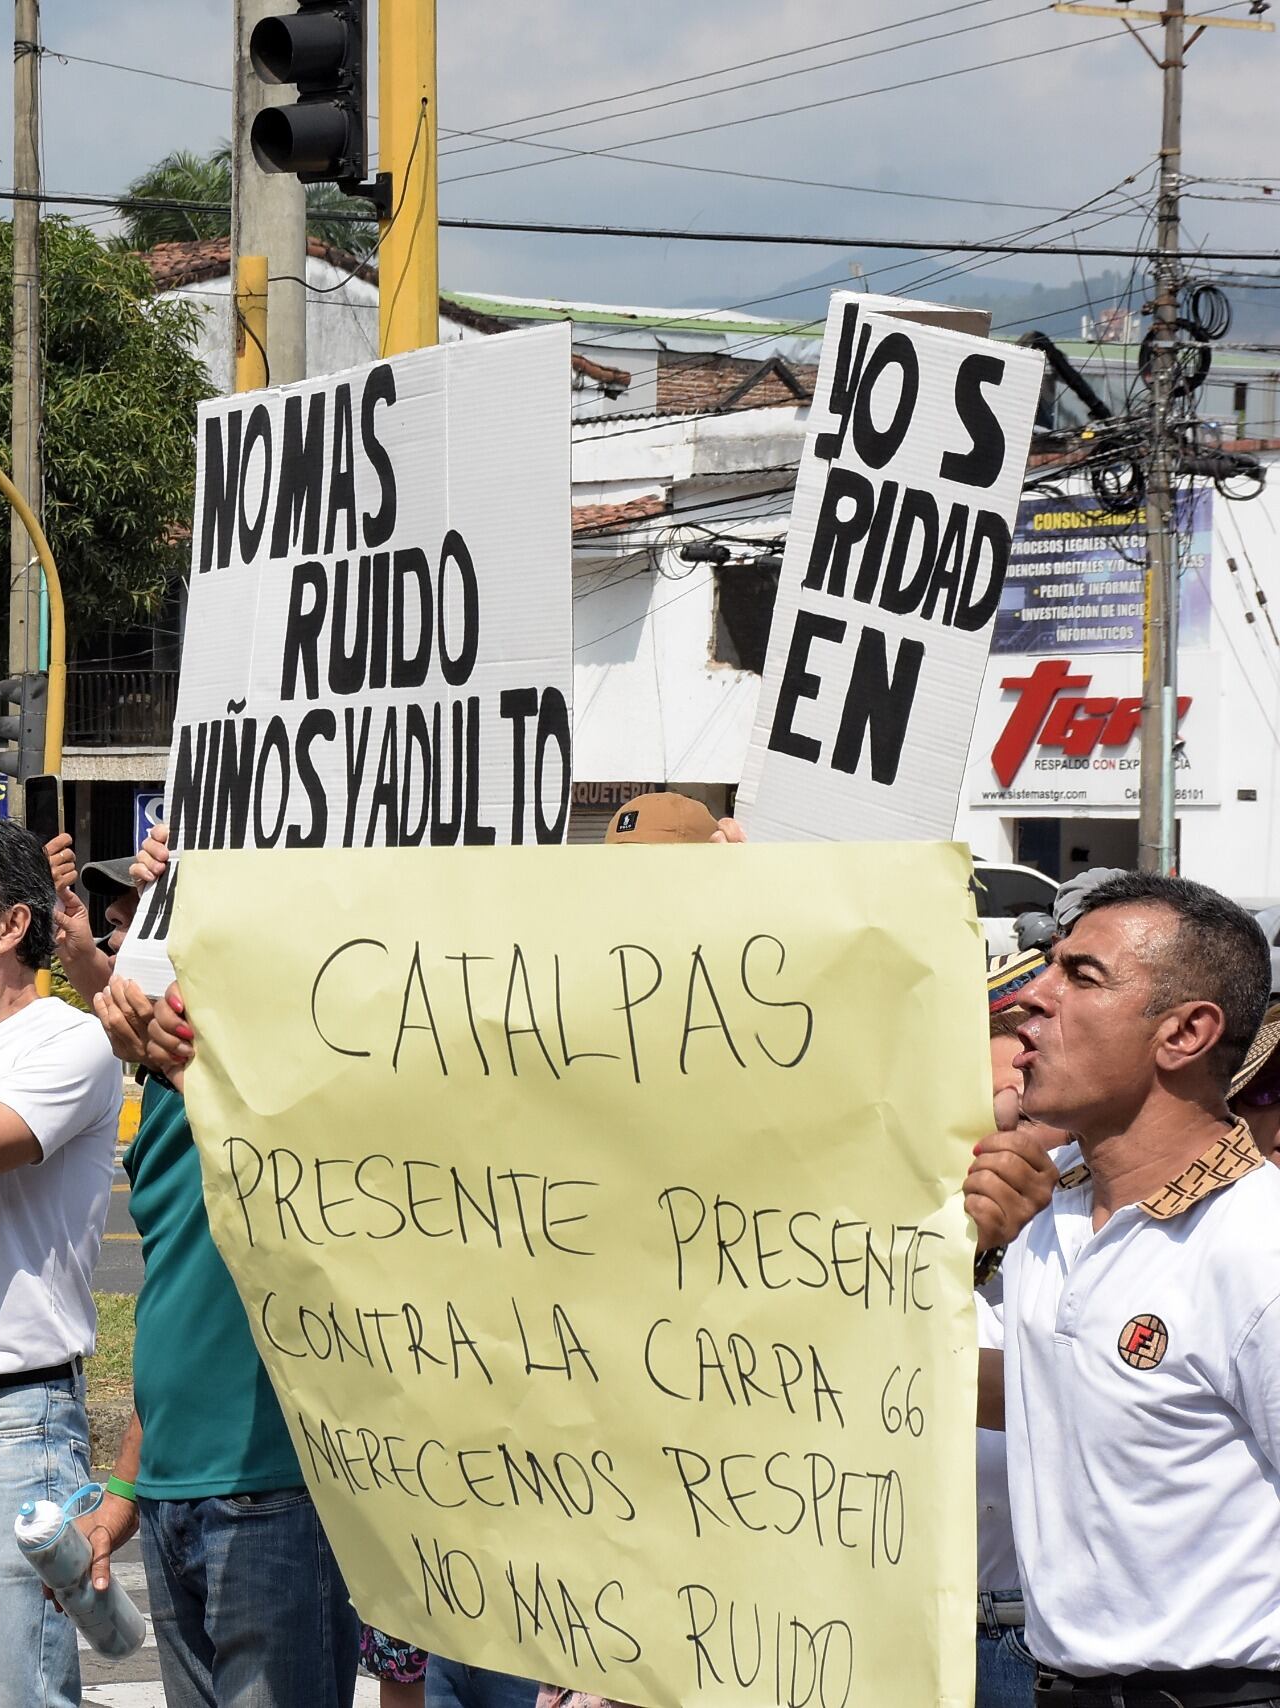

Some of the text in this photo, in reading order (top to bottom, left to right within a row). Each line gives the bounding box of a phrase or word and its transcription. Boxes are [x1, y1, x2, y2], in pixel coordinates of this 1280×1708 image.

[280, 529, 479, 701] RUIDO
[802, 466, 1013, 633] RIDAD
[1054, 559, 1104, 575] DIGITALES
[1065, 537, 1107, 553] LEGALES
[768, 609, 925, 787] EN
[1034, 759, 1089, 771] RESPALDO
[1092, 759, 1117, 771] CON
[982, 789, 1087, 802] www.sistemastgr.com
[312, 933, 814, 1083] CATALPAS
[222, 1136, 946, 1314] PRESENTE PRESENTE
[262, 1291, 925, 1438] CONTRA LA CARPA 66
[298, 1411, 905, 1569] MERECEMOS RESPETO
[410, 1533, 853, 1708] NO MAS RUIDO
